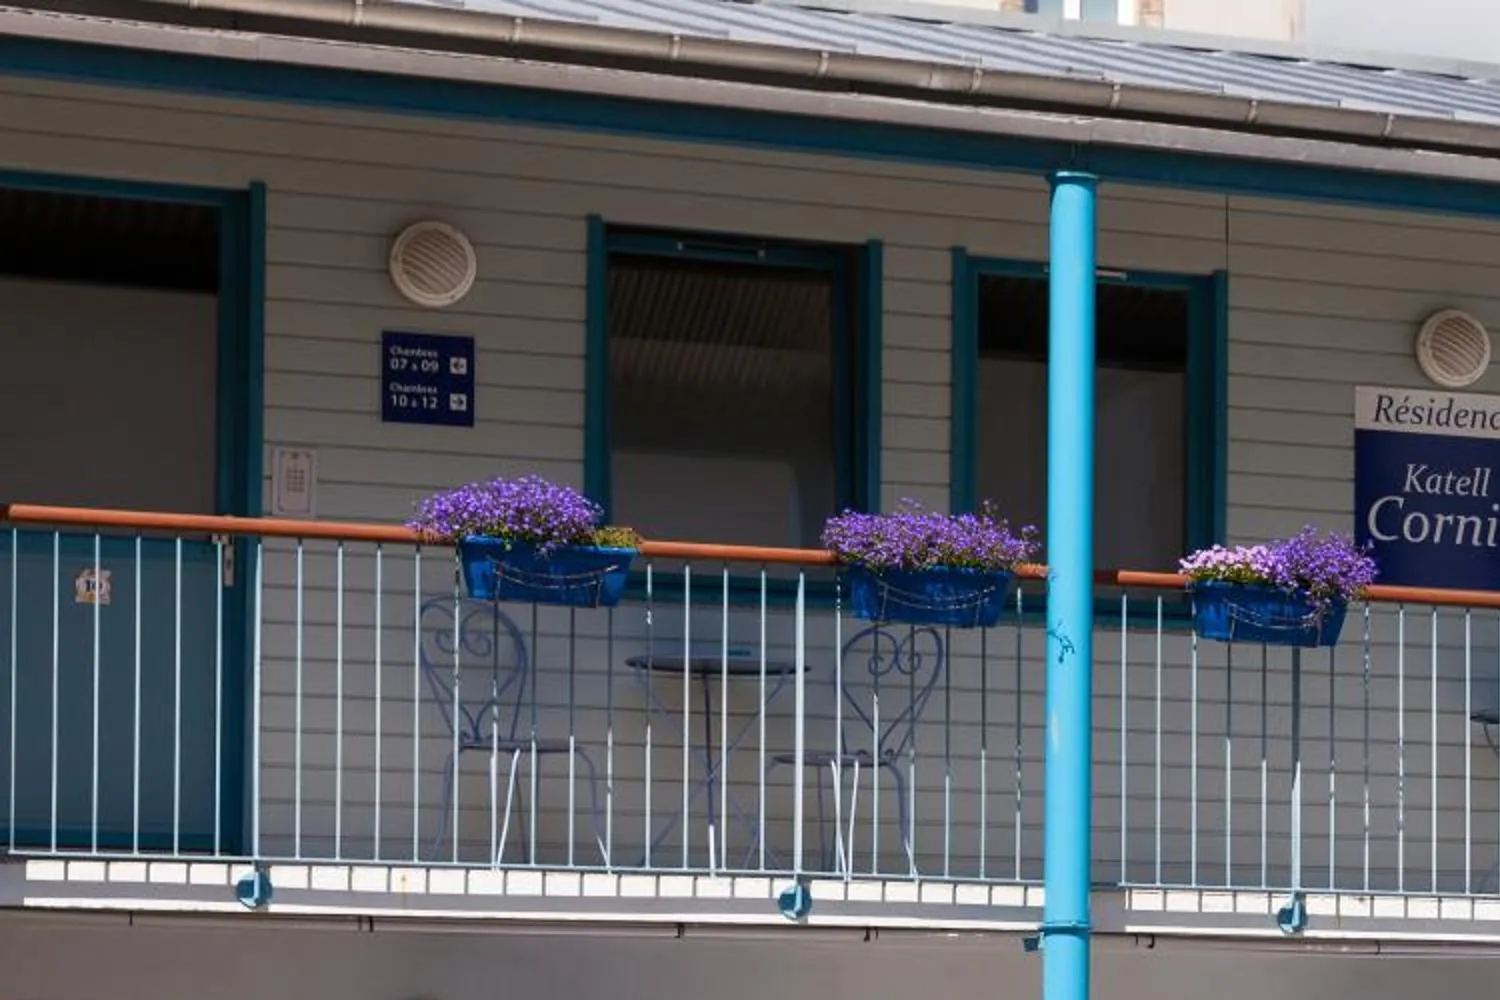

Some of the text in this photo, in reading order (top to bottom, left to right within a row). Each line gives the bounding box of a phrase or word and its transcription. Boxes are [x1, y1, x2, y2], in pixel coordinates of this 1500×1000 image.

[389, 345, 438, 358] Chambres
[389, 357, 408, 371] 07
[421, 359, 439, 374] 09
[389, 381, 438, 395] Chambres
[391, 394, 408, 408] 10
[421, 396, 438, 410] 12
[1403, 463, 1492, 497] Katell
